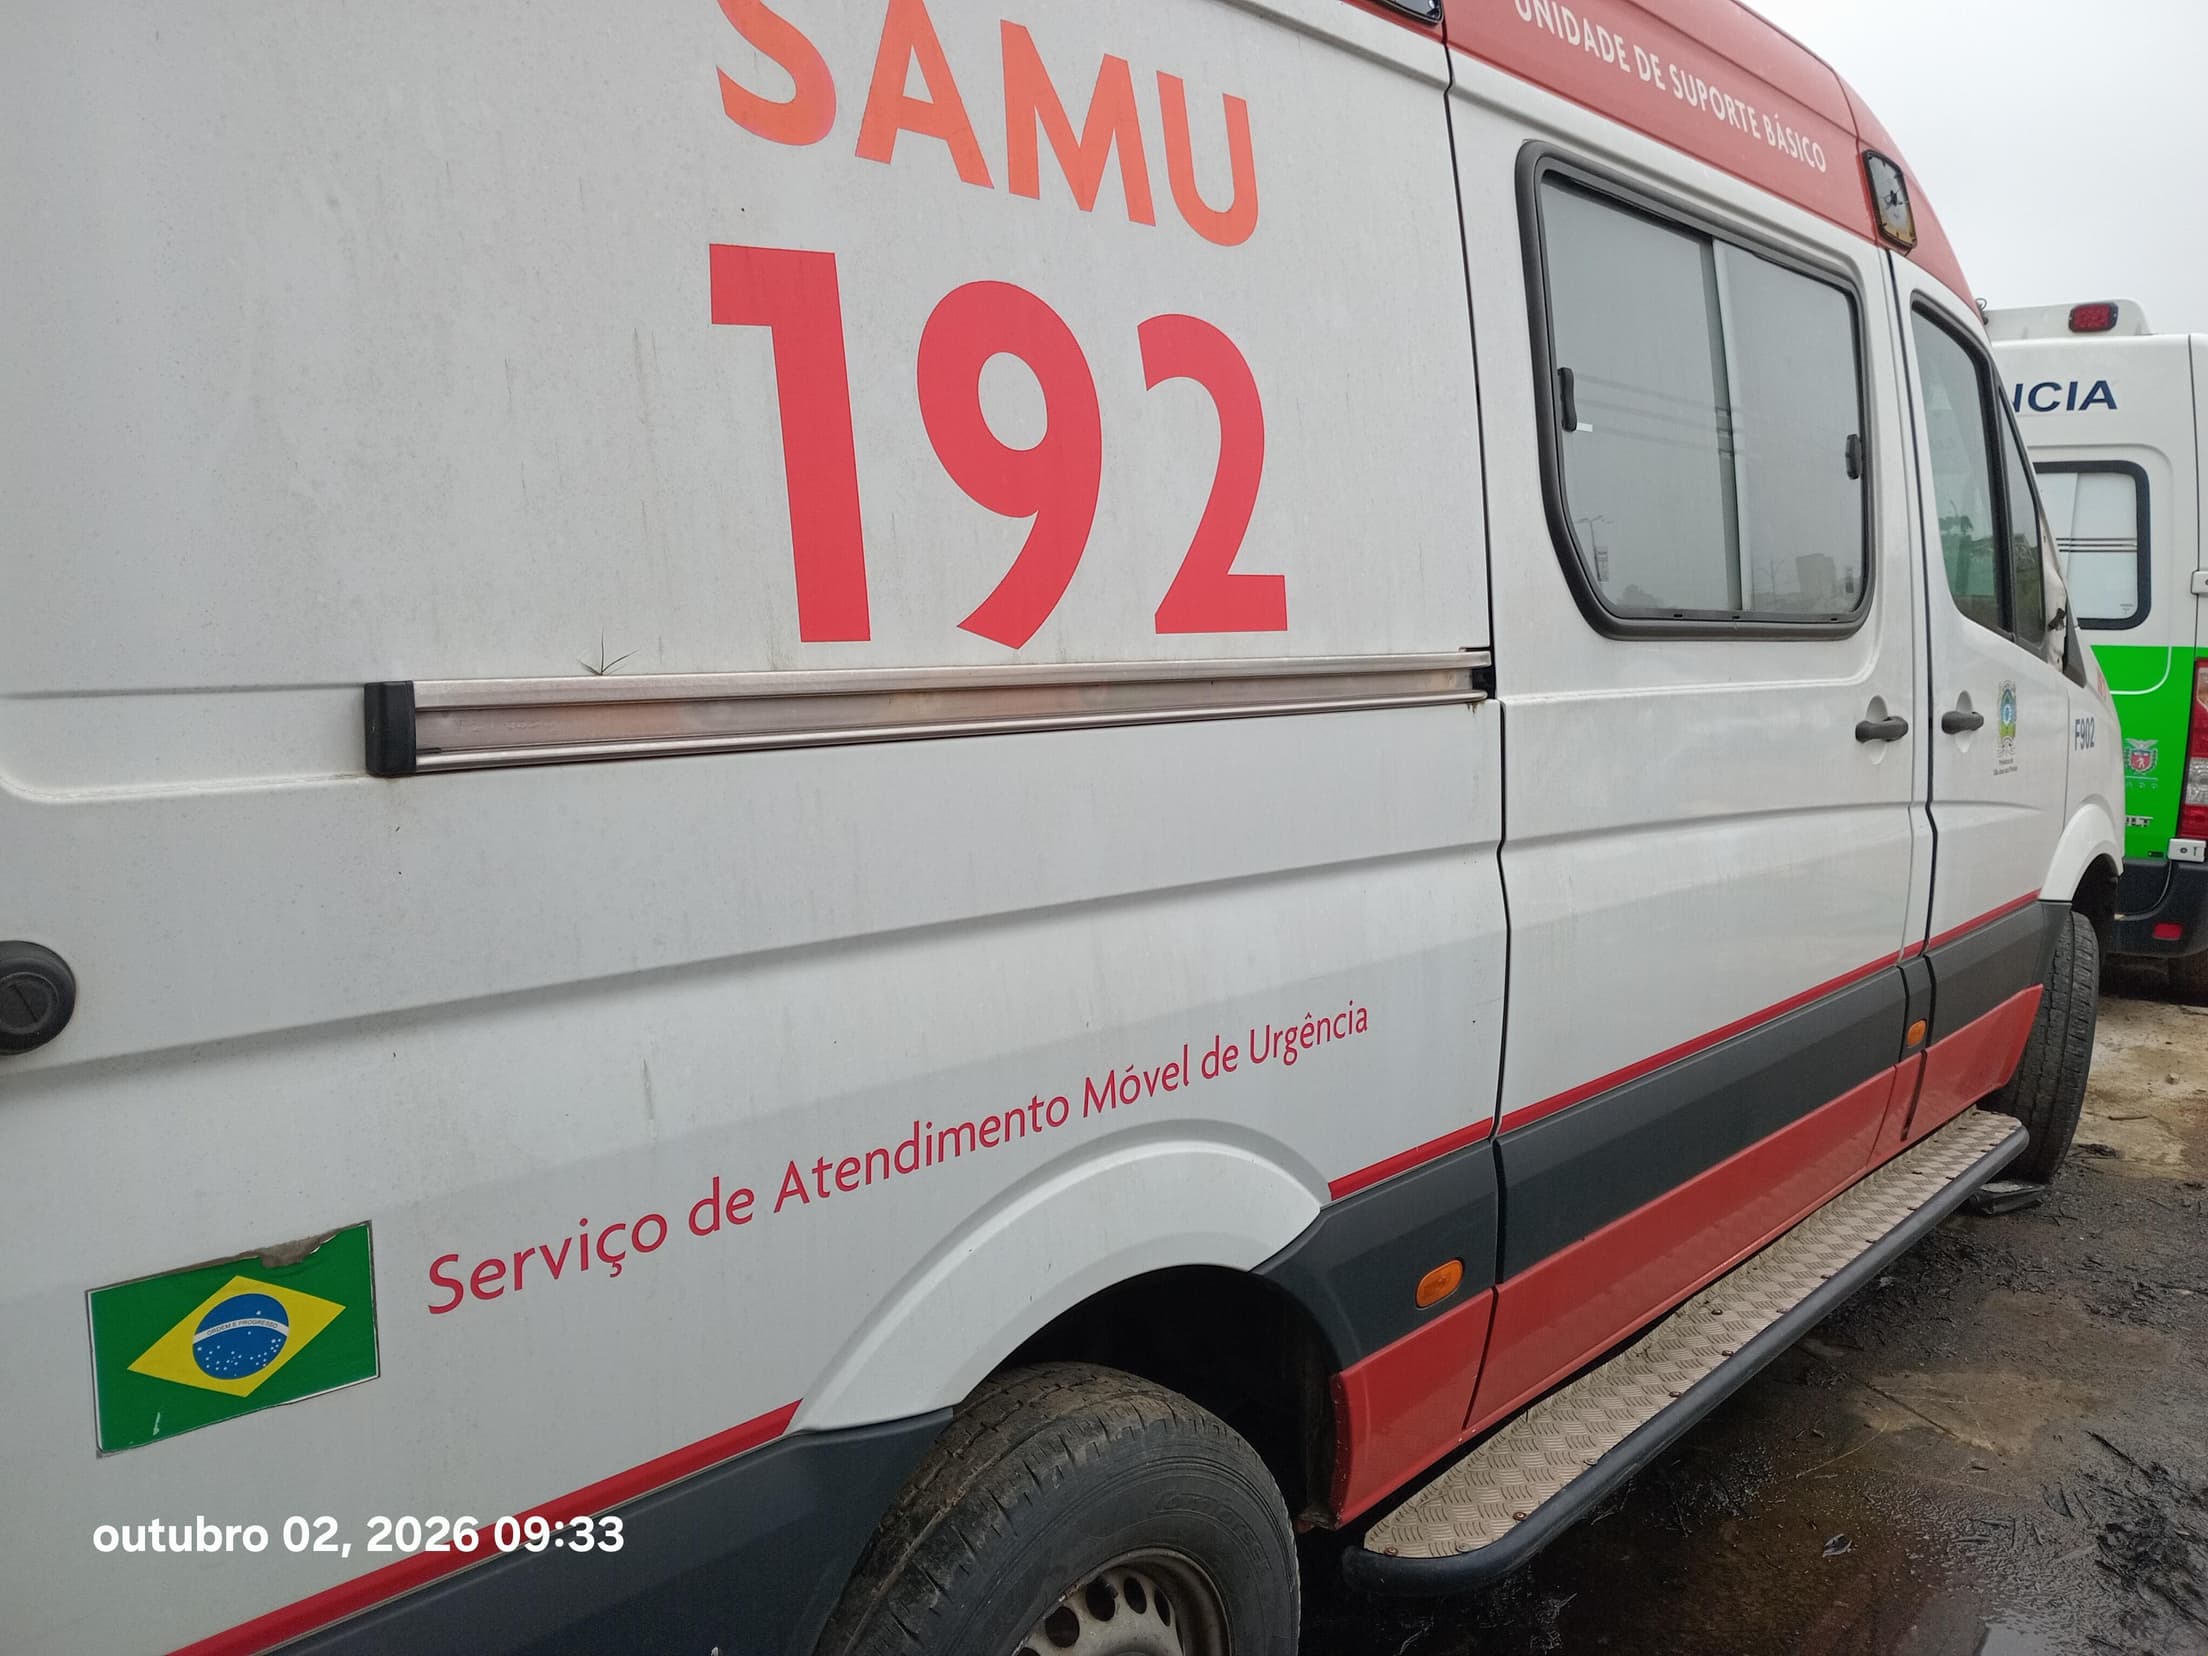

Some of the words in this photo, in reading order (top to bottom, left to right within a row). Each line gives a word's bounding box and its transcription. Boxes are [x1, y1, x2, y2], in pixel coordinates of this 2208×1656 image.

[716, 0, 1259, 247] SAMU
[1515, 0, 1630, 73] UNIDADE
[1633, 44, 1666, 91] DE
[1669, 63, 1761, 139] SUPORTE
[1763, 113, 1827, 173] BÁSICO
[709, 243, 1288, 650] 192
[428, 1213, 668, 1315] Serviço
[688, 1176, 755, 1237] de
[773, 1095, 1070, 1214] Atendimento
[1083, 1044, 1190, 1119] Móvel
[1201, 1035, 1239, 1080] de
[1249, 1000, 1369, 1066] Urgência
